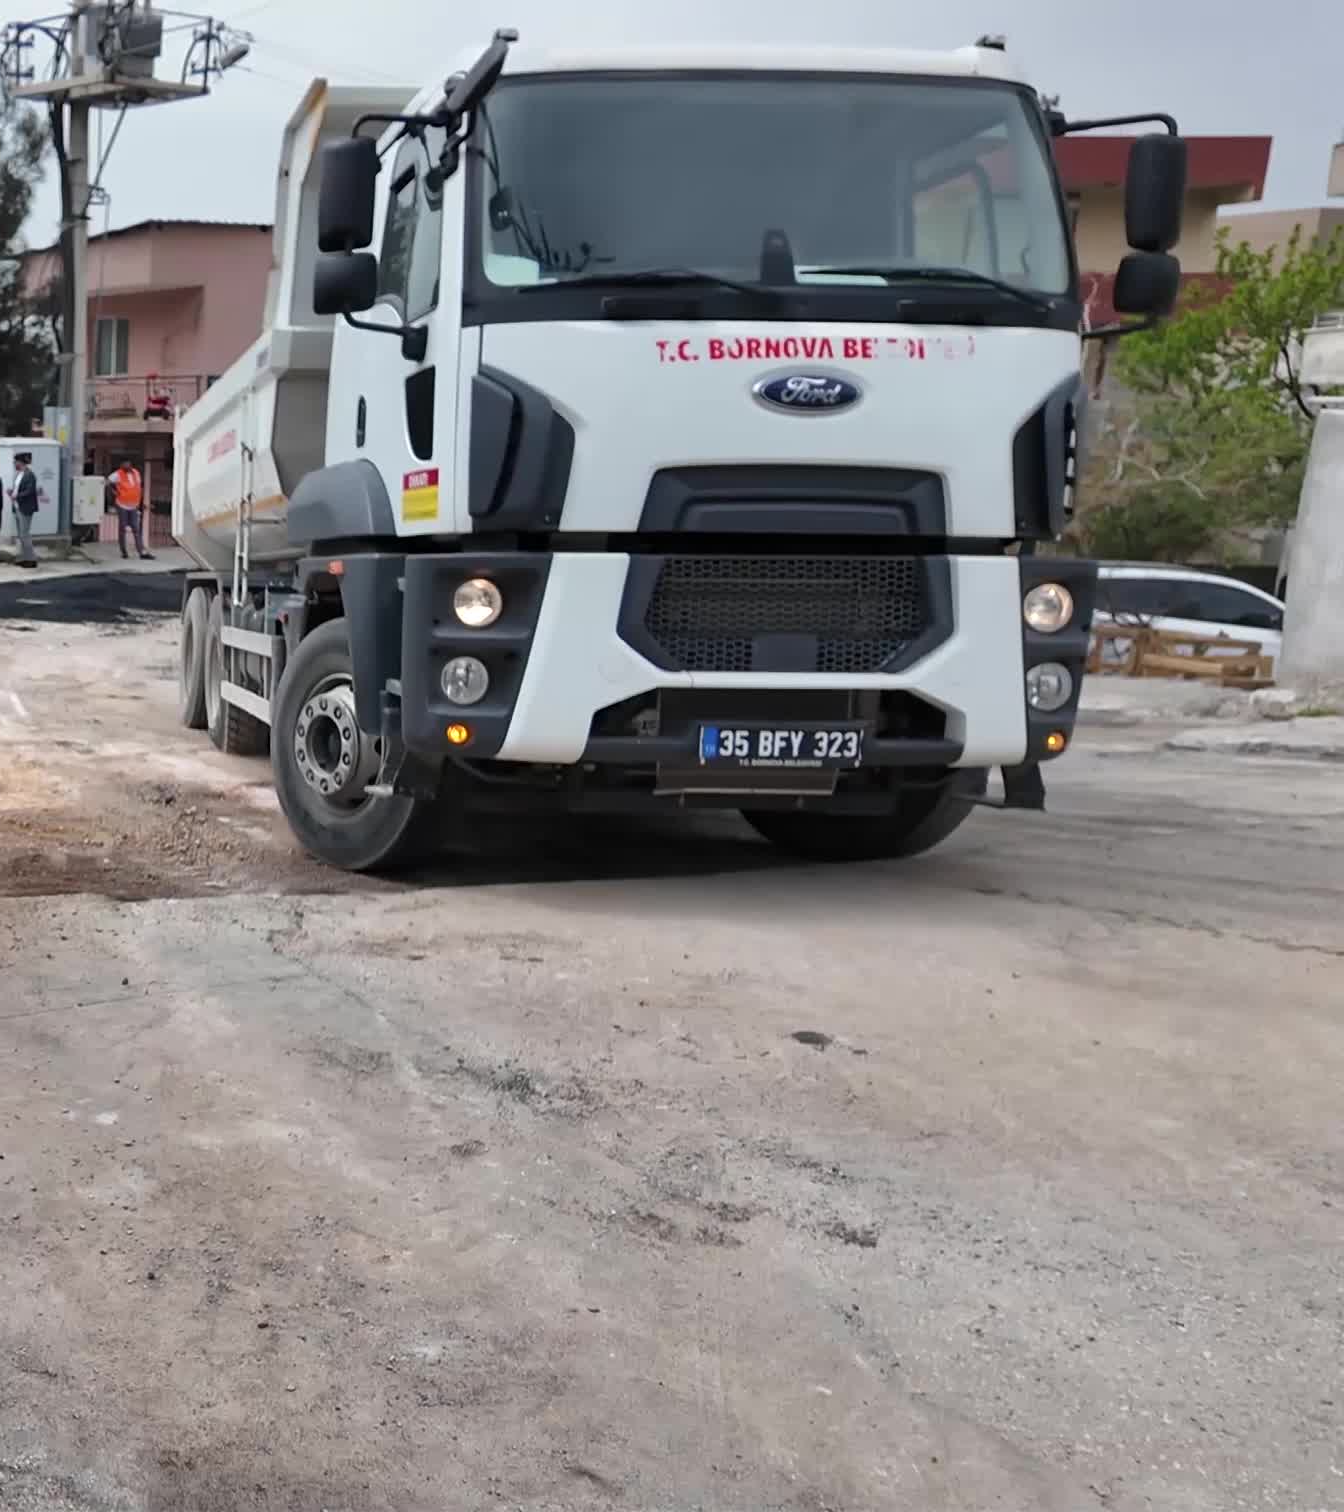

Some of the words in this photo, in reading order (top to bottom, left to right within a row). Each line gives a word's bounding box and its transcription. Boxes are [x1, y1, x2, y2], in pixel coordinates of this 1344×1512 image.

[656, 340, 699, 362] T.C.
[709, 337, 834, 360] BORNOVA
[780, 376, 841, 403] Ford
[720, 730, 750, 757] 35
[758, 730, 805, 757] BFY
[813, 731, 858, 758] 323
